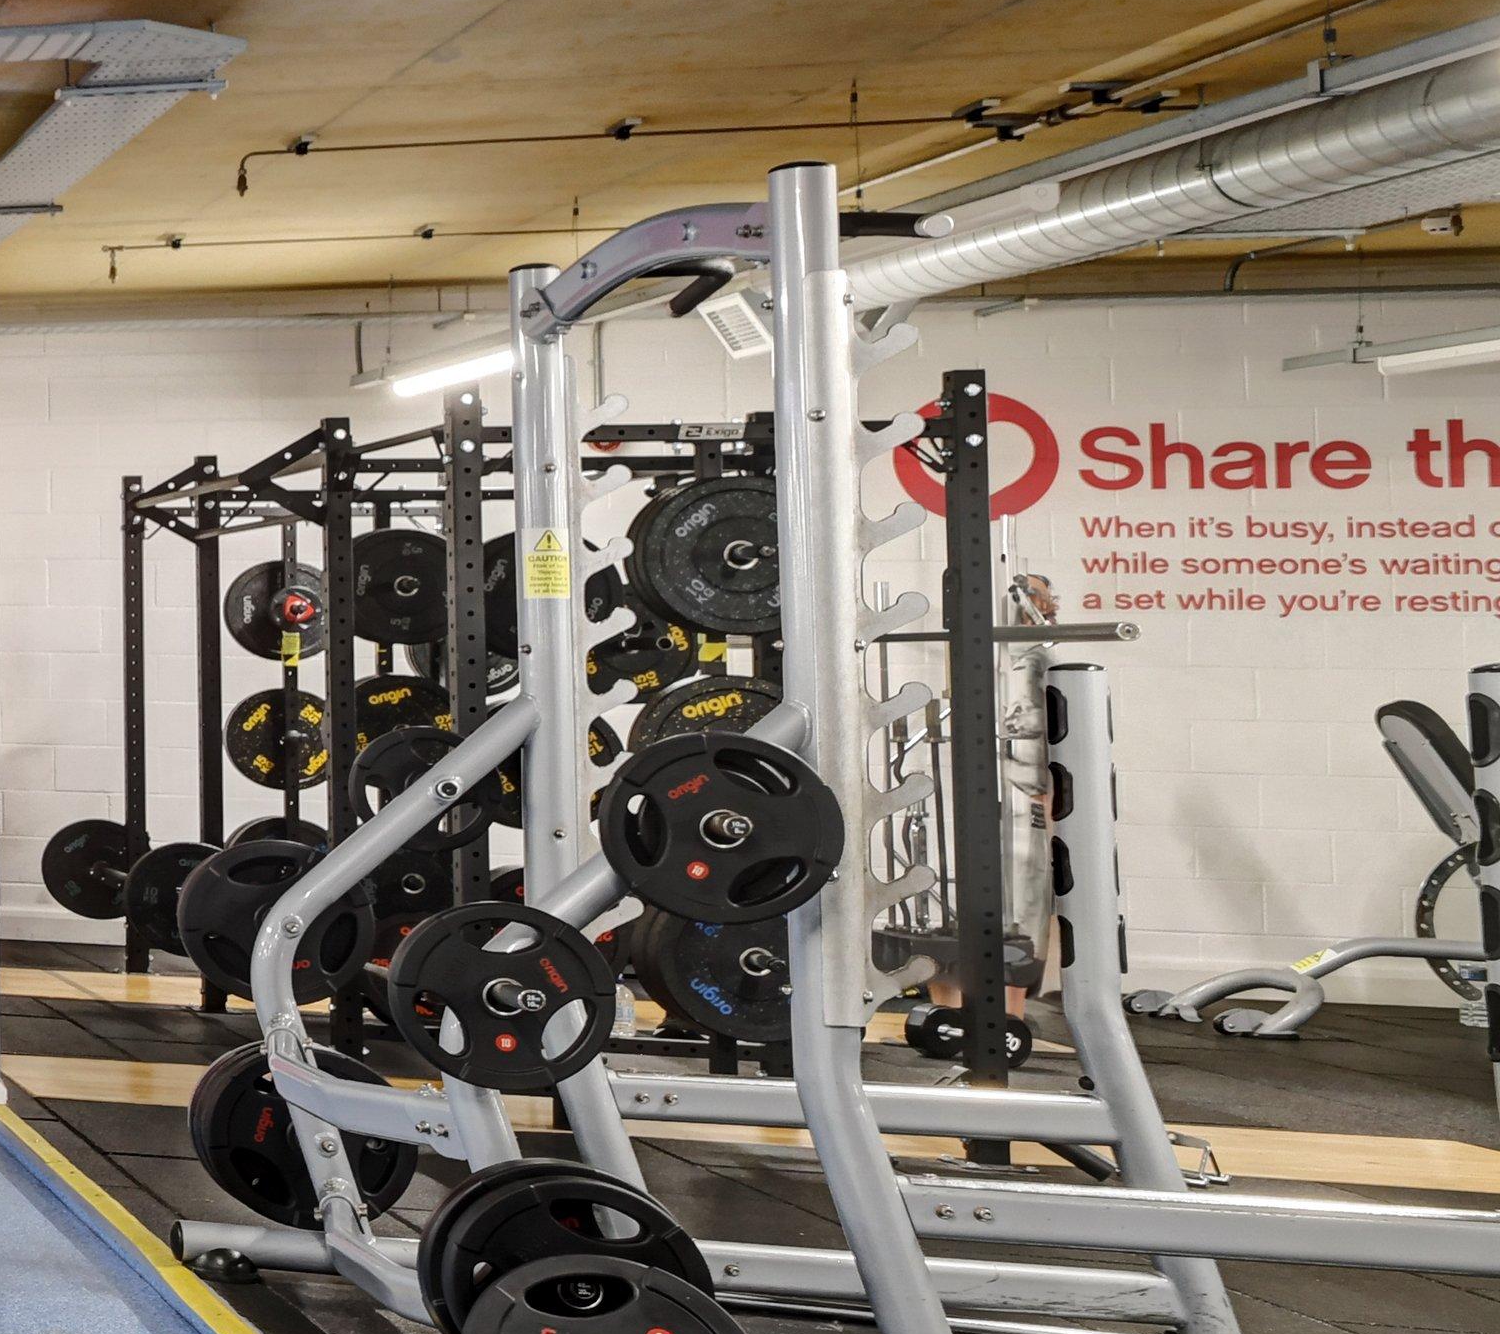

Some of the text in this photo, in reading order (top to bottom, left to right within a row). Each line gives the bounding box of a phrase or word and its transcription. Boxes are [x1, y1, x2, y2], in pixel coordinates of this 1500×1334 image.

[706, 428, 739, 437] Exigo
[1078, 419, 1500, 489] Share th
[674, 501, 716, 538] origin
[1079, 516, 1175, 539] When
[1188, 516, 1234, 539] it's
[1246, 515, 1335, 545] busy,
[1347, 515, 1476, 539] instead
[1080, 551, 1169, 575] while
[1181, 552, 1368, 575] someone's
[1081, 593, 1103, 611] a
[1115, 590, 1164, 611] set
[1177, 588, 1267, 611] while
[1278, 589, 1382, 617] you're
[368, 686, 412, 706] origin
[681, 691, 744, 719] origin
[242, 703, 271, 732] origin
[668, 774, 710, 799] origin
[540, 957, 569, 994] origin
[689, 977, 733, 1016] origin
[252, 1105, 274, 1144] origin
